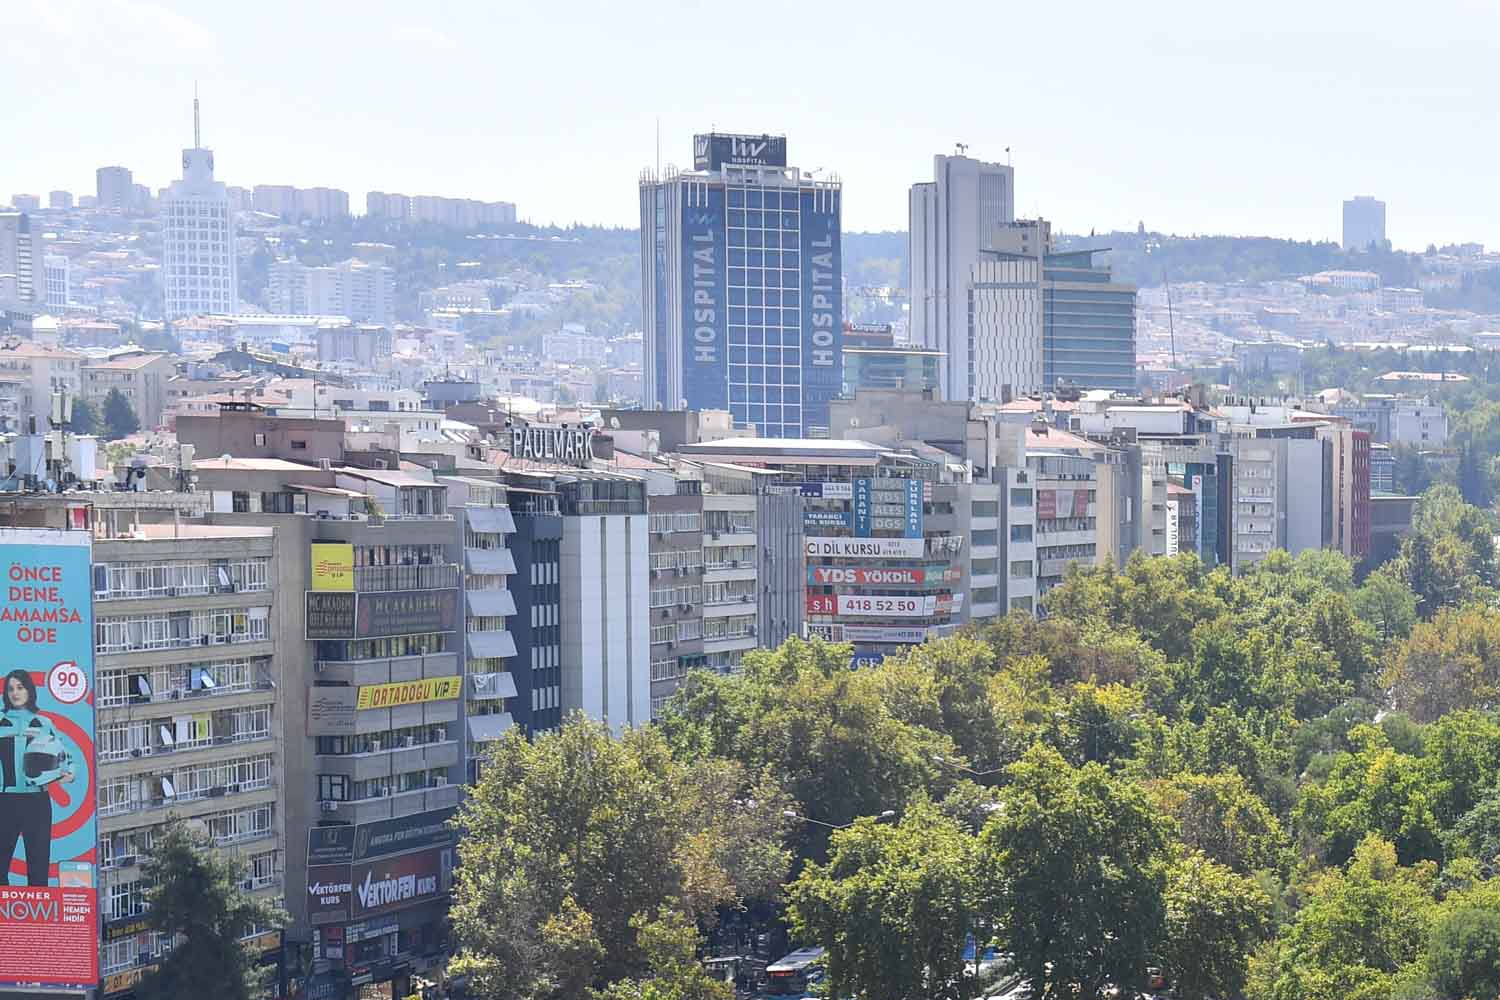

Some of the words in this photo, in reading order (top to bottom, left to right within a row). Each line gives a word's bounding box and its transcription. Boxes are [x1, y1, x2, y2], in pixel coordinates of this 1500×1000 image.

[693, 229, 716, 362] HOSPITAL
[812, 238, 834, 366] HOSPITAL
[513, 428, 595, 460] PAULMARK
[844, 543, 881, 556] KURSU
[9, 562, 62, 582] ÖNCE
[819, 568, 857, 583] YDS
[9, 587, 64, 606] DENE,
[846, 600, 872, 611] 418
[876, 600, 893, 611] 52
[897, 600, 916, 612] 50
[17, 624, 57, 643] ÖDE
[58, 672, 79, 687] 90
[2, 891, 50, 899] BOYNER
[320, 896, 340, 905] KURS
[63, 905, 91, 914] HEMEN
